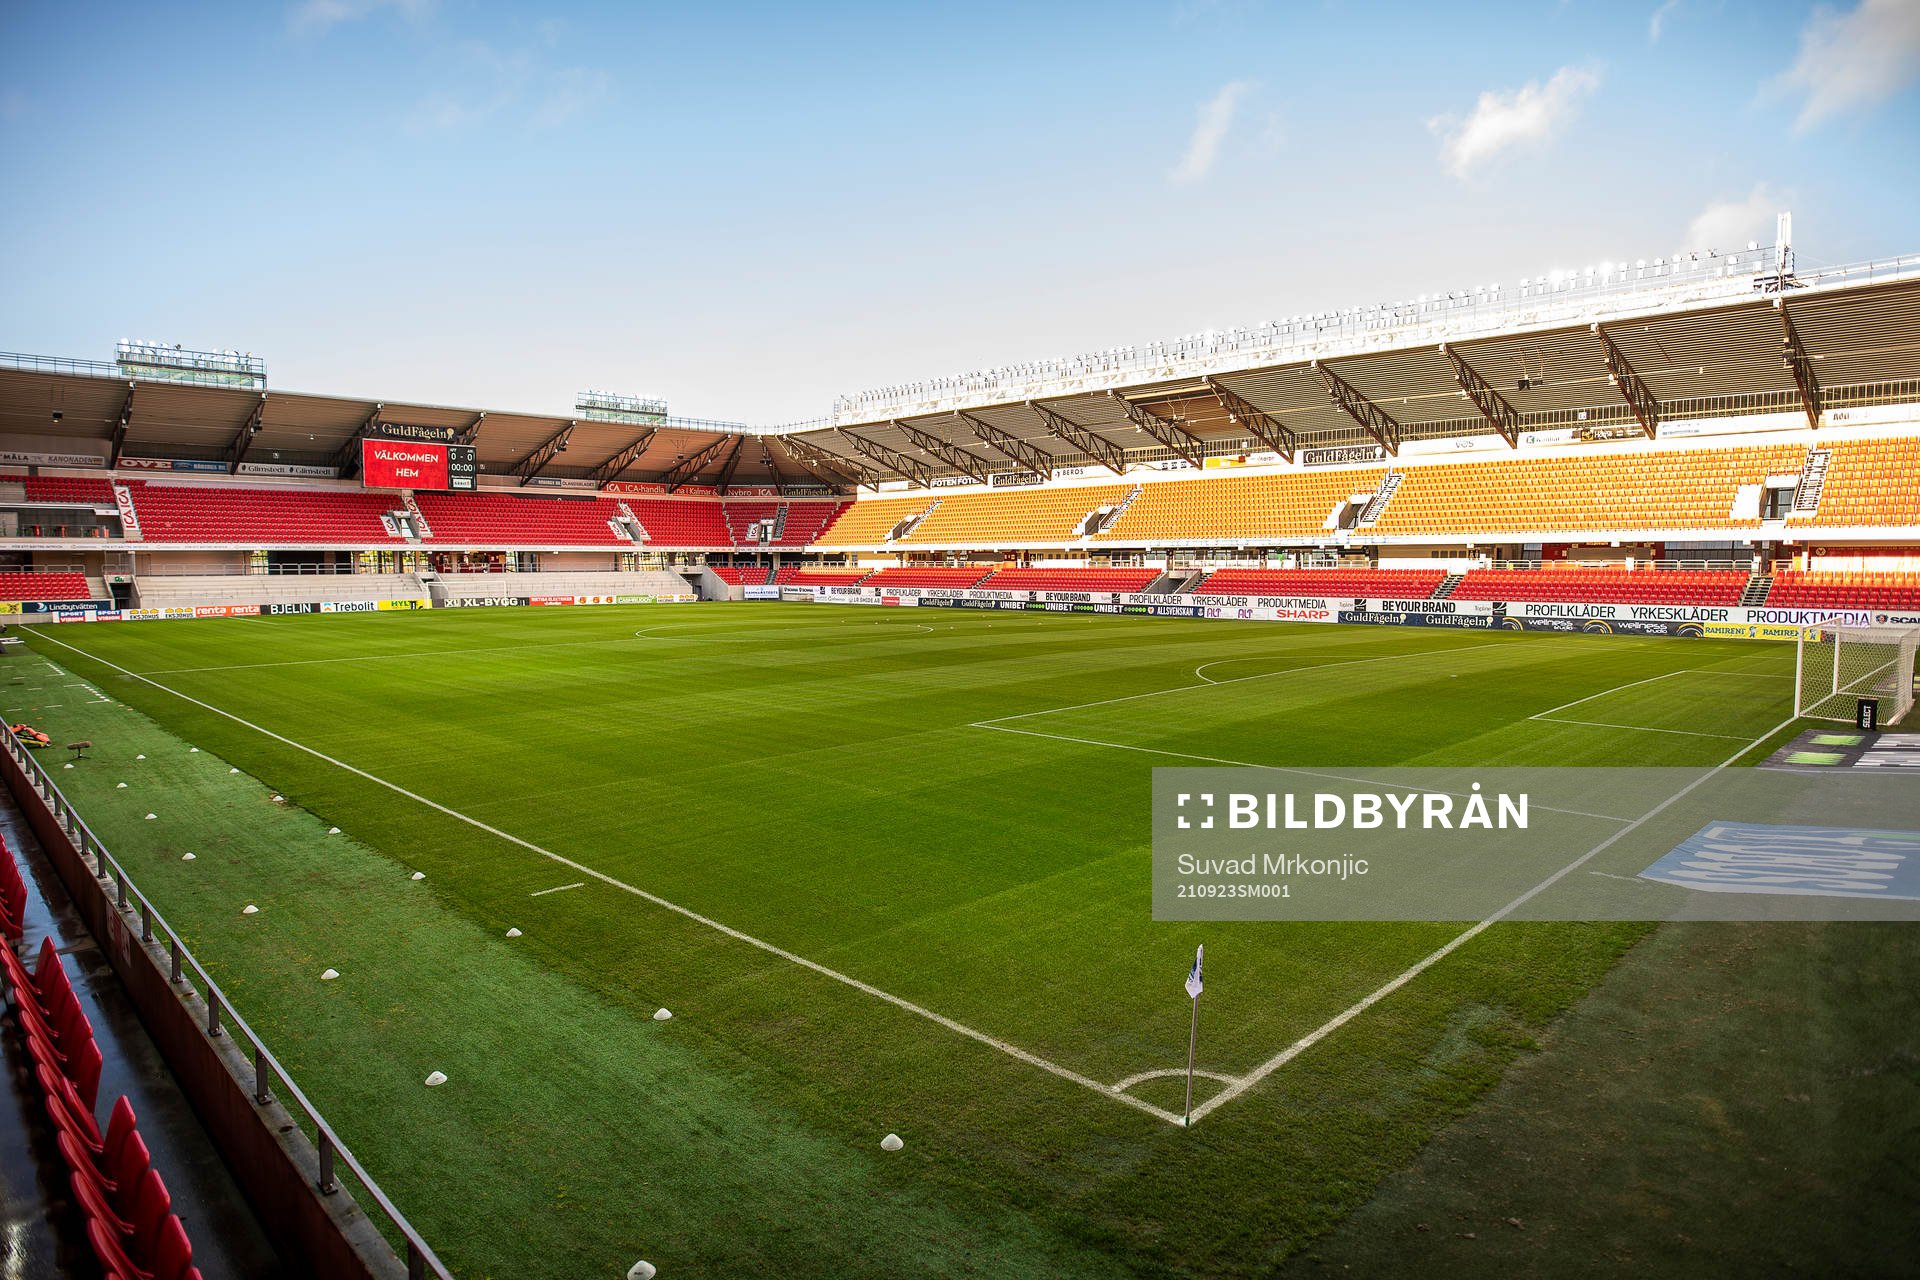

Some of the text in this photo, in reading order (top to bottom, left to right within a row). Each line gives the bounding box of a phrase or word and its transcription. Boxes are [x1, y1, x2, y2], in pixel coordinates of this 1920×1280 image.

[382, 423, 447, 440] GuldFågeln
[374, 450, 439, 463] VÄLKOMMEN
[1306, 448, 1373, 464] GuldFågeln
[121, 460, 172, 469] OVE
[249, 465, 285, 473] Glimstedt
[451, 463, 473, 471] 00:00
[395, 468, 419, 478] HEM
[957, 476, 980, 485] FOTE
[994, 474, 1037, 486] GuldFågeln
[606, 484, 620, 492] ICA
[728, 489, 752, 497] Nybro
[118, 489, 130, 508] ICA
[123, 509, 136, 529] ICA
[886, 588, 922, 597] PROFILKLÄDER
[926, 589, 964, 598] YRKESKLÄDER
[969, 590, 1013, 599] PRODUKTMEDIA
[333, 601, 375, 612] Trebolit
[463, 597, 518, 607] XL-BYGG
[922, 599, 951, 607] GuldFågeln
[961, 599, 992, 609] GuldFågeln
[1000, 601, 1026, 610] UNIBET
[1045, 602, 1074, 611] UNIBET
[1129, 594, 1327, 609] PROFILKLÄDER YRKESKLÄDER PRODUKTMEDIA
[49, 603, 98, 611] Lindbytvätten
[197, 606, 227, 615] renta
[231, 605, 260, 614] renta
[270, 603, 311, 614] BJELIN
[1093, 604, 1124, 613] UNIBET
[1157, 606, 1194, 616] ALLSVENSKAN
[1422, 602, 1456, 613] BRAND
[1276, 609, 1330, 620] SHARP
[1345, 612, 1399, 625] GuldFågeln
[1525, 604, 1870, 626] PROFILKLÄDER YRKESKLÄDER PRODUKTMEDIA
[1425, 614, 1487, 628] GuldFågeln
[1618, 622, 1668, 630] wellness
[1705, 627, 1746, 635] RAMIRENT
[1762, 628, 1803, 637] RAMIRE
[1862, 705, 1871, 729] SELECT
